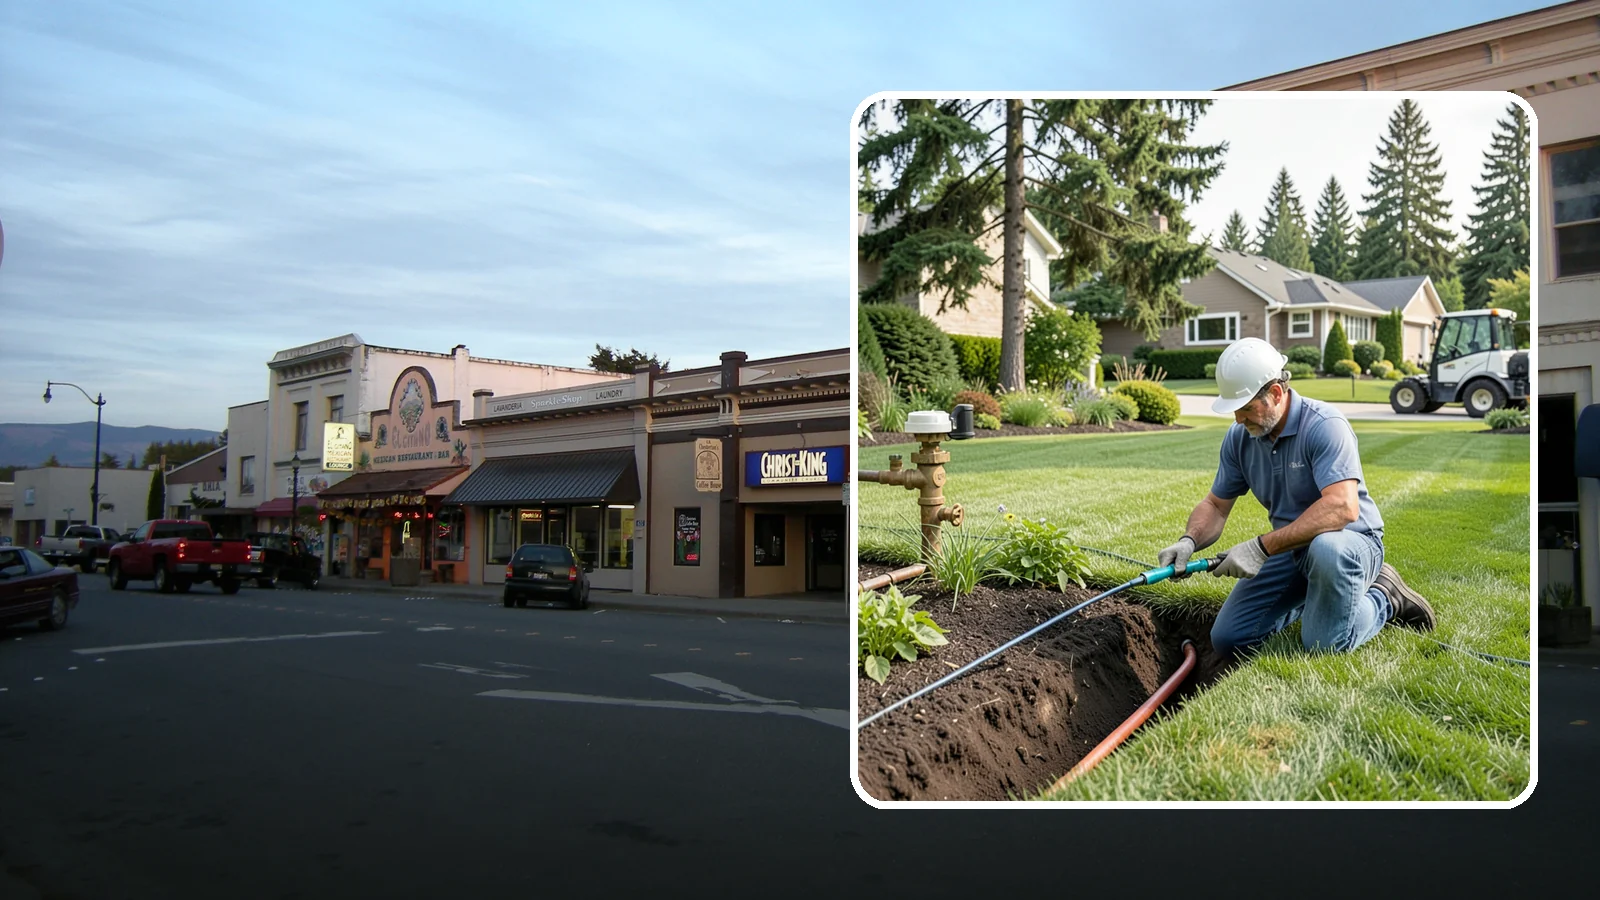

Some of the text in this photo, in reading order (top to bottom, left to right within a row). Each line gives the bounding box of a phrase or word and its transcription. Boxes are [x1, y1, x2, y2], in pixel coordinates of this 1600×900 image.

[494, 402, 522, 412] LAVANDERIA
[596, 389, 623, 399] LAUNDRY
[374, 455, 396, 464] MEXICAN
[397, 452, 433, 462] RESTAURANT
[438, 450, 450, 459] BAR
[761, 450, 827, 477] CHRIST KING
